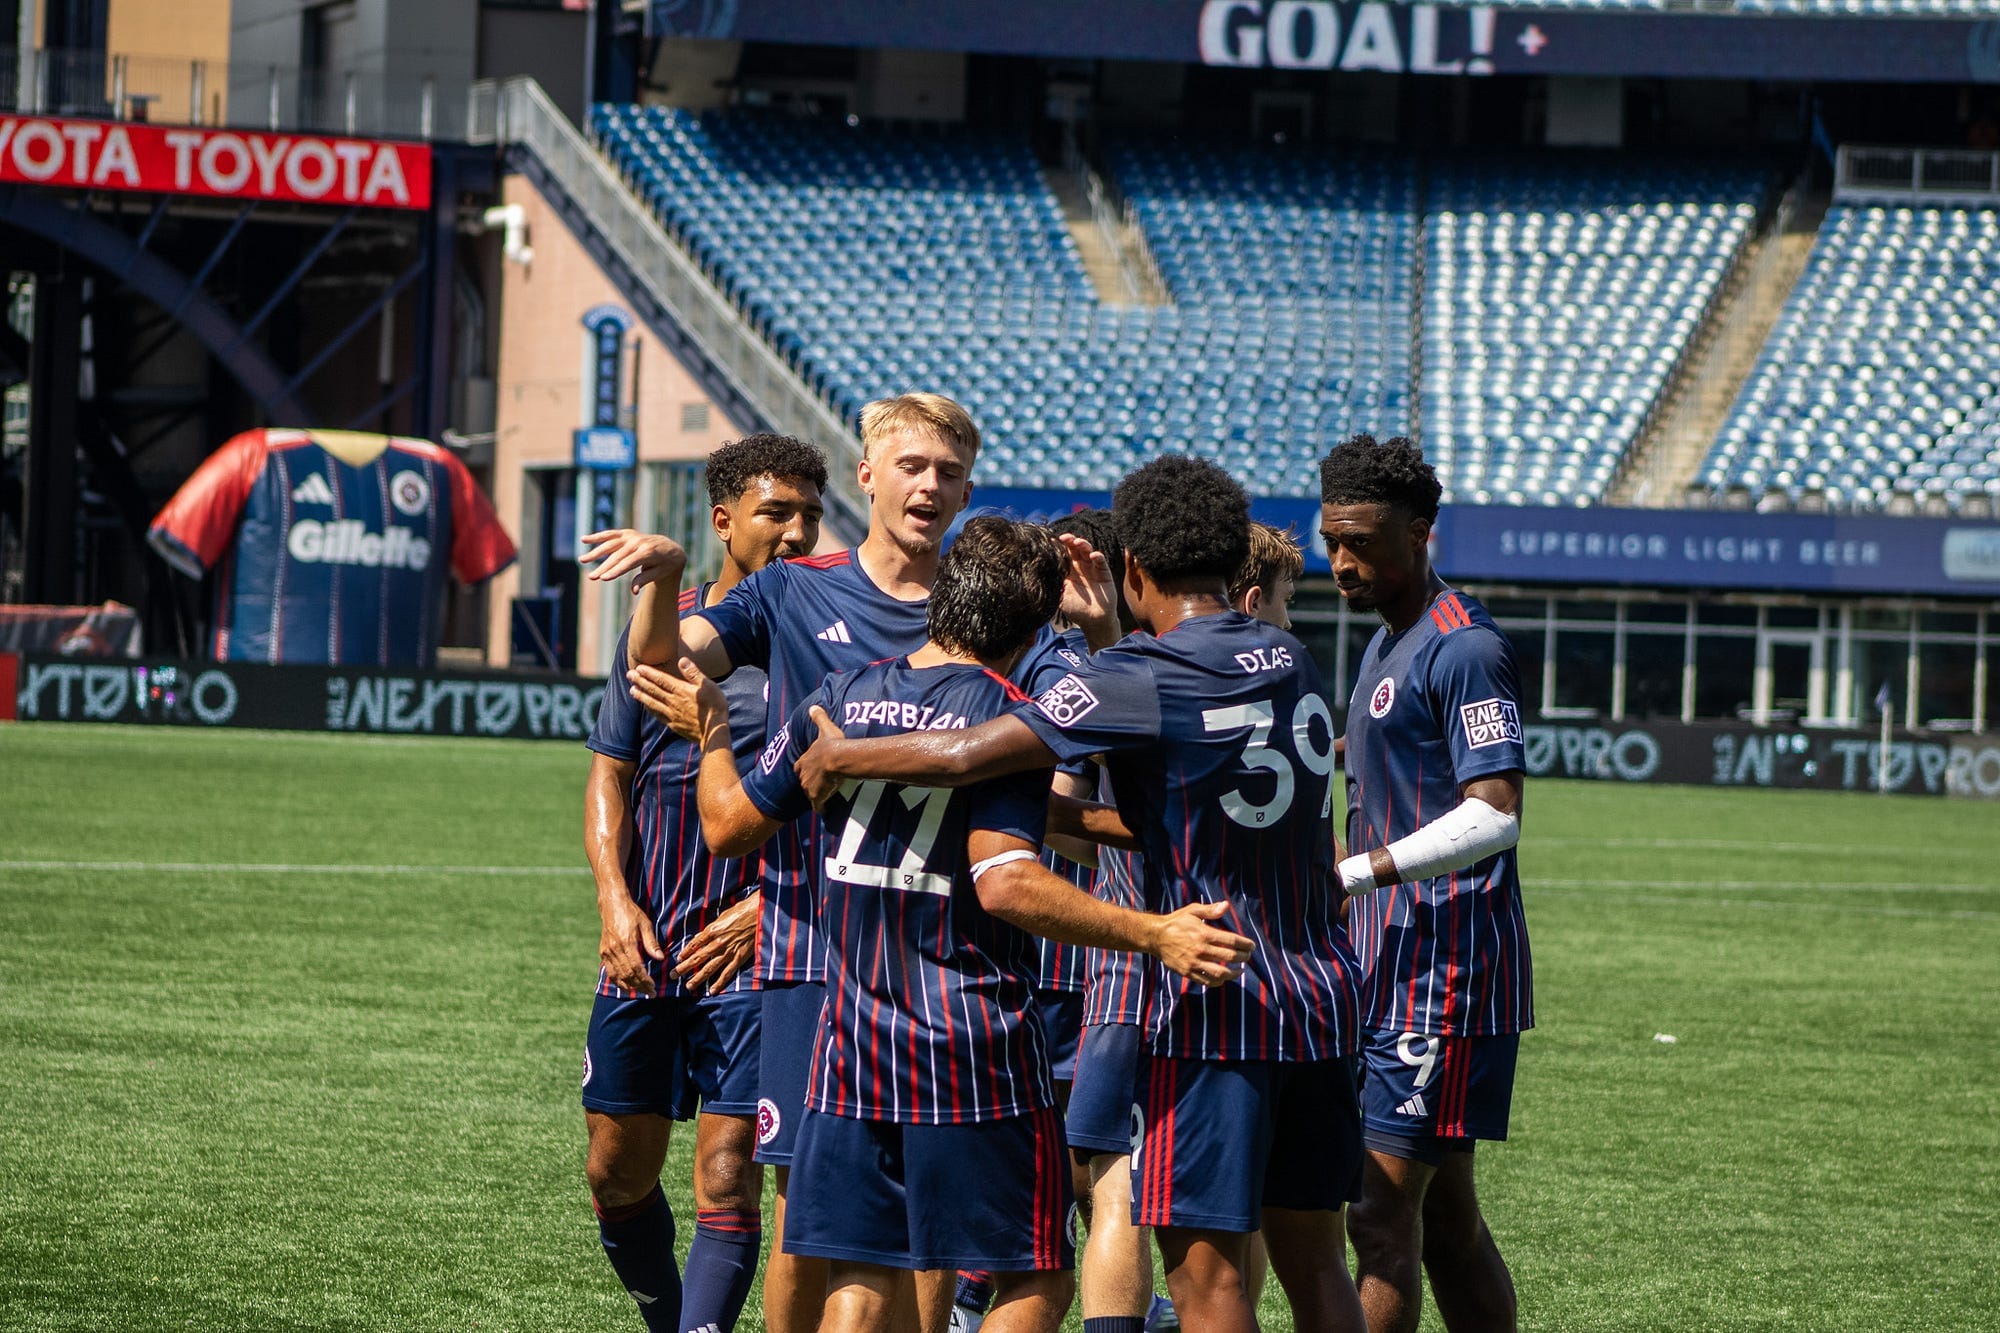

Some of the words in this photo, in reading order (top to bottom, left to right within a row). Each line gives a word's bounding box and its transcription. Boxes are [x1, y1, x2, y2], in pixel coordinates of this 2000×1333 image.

[1199, 0, 1497, 76] GOAL!
[165, 130, 411, 205] TOYOTA
[288, 518, 432, 573] Gillette
[1500, 529, 1668, 559] SUPERIOR
[1683, 534, 1783, 564] LIGHT
[1799, 539, 1881, 567] BEER
[1234, 646, 1294, 674] DIAS
[1477, 702, 1513, 725] NEXT
[1201, 692, 1336, 829] 39
[1397, 1031, 1440, 1087] 9
